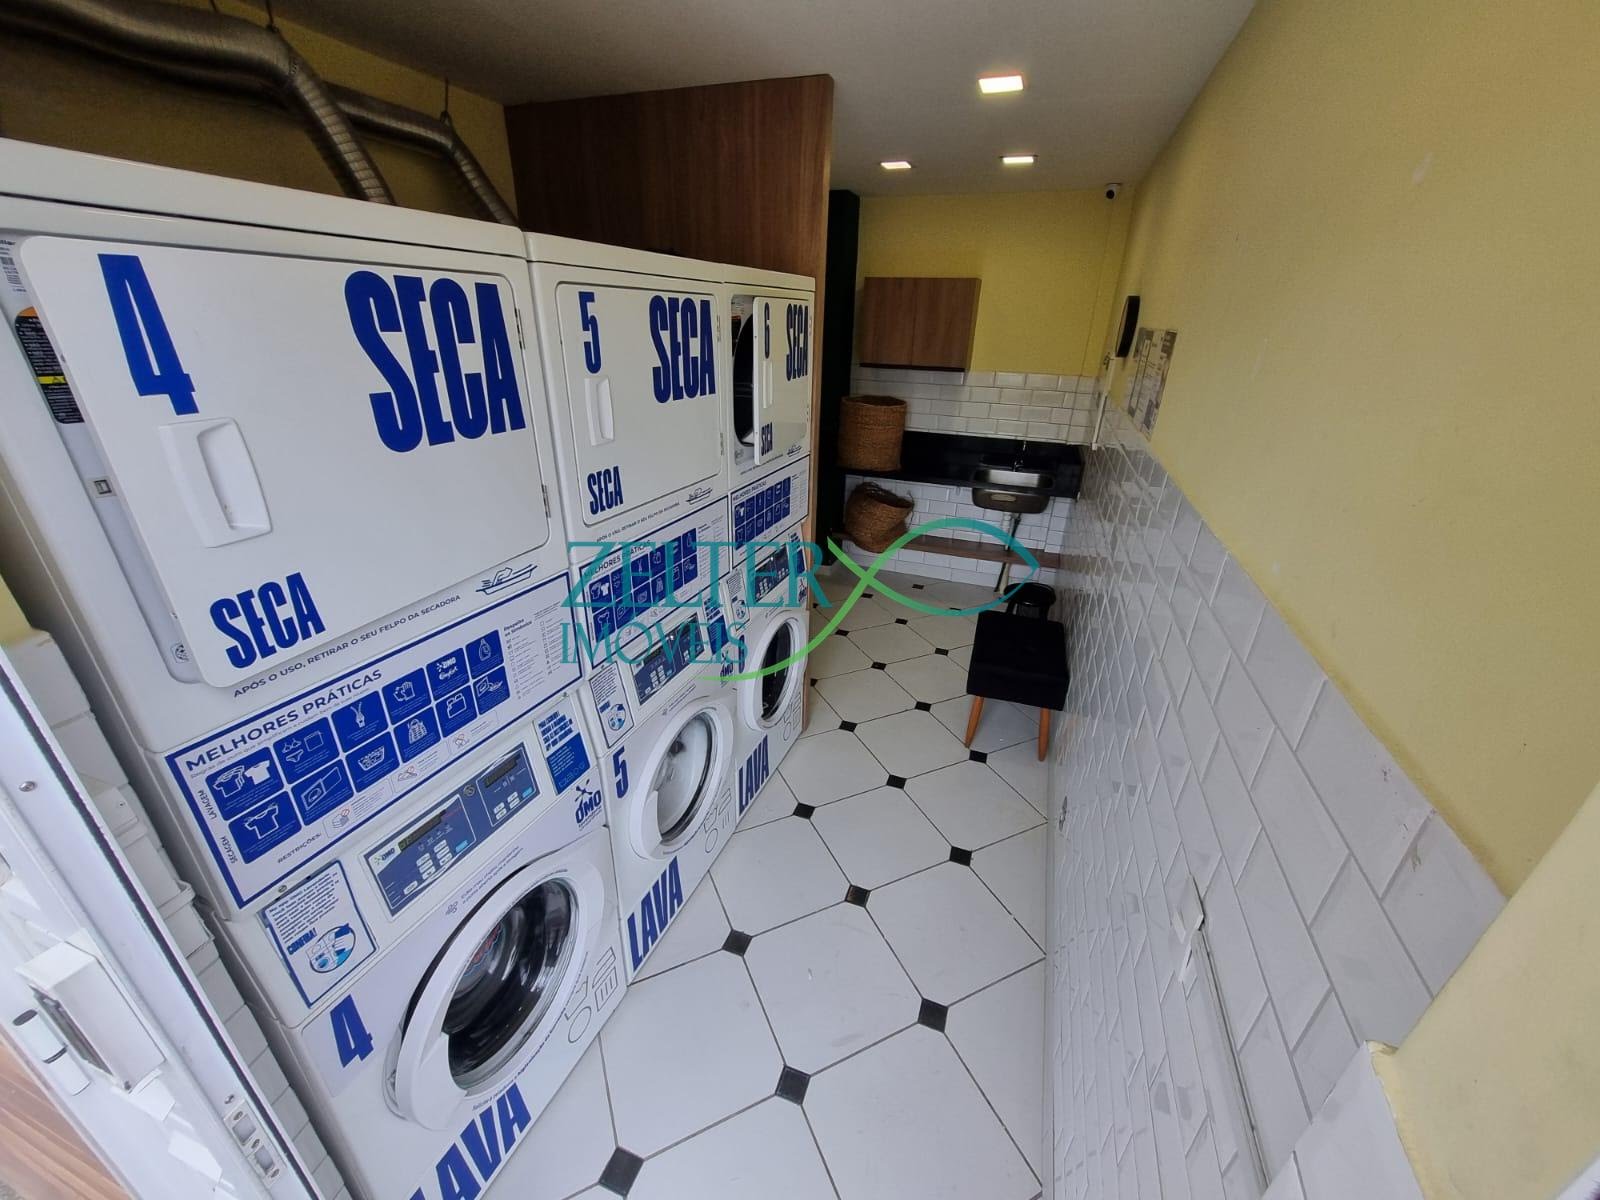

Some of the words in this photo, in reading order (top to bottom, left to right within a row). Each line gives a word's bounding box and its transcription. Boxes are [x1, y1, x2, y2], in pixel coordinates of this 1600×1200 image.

[98, 252, 200, 416] 4
[344, 271, 526, 453] SECA
[578, 291, 602, 374] 5
[648, 295, 716, 404] SECA
[764, 302, 770, 359] 6
[786, 303, 809, 382] SECA
[587, 466, 624, 516] SECA
[208, 571, 326, 670] SECA
[233, 677, 266, 698] APÓS
[269, 673, 278, 682] O
[280, 662, 306, 677] USO,
[306, 642, 350, 665] RETIRAR
[350, 637, 360, 646] O
[360, 629, 378, 641] SEU
[379, 617, 407, 634] FELPO
[407, 612, 420, 621] DA
[420, 594, 462, 615] SECADORA
[185, 710, 299, 772] MELHORES
[302, 669, 382, 714] PRÁTICAS
[197, 789, 218, 820] LAVAGEM
[575, 790, 602, 824] OMO
[612, 745, 629, 799] 5
[738, 734, 770, 816] LAVA
[221, 835, 238, 865] SECAGEM
[286, 927, 318, 956] CONFIRA!
[627, 856, 684, 972] LAVA
[329, 994, 376, 1068] 4
[408, 1082, 532, 1200] AVA
